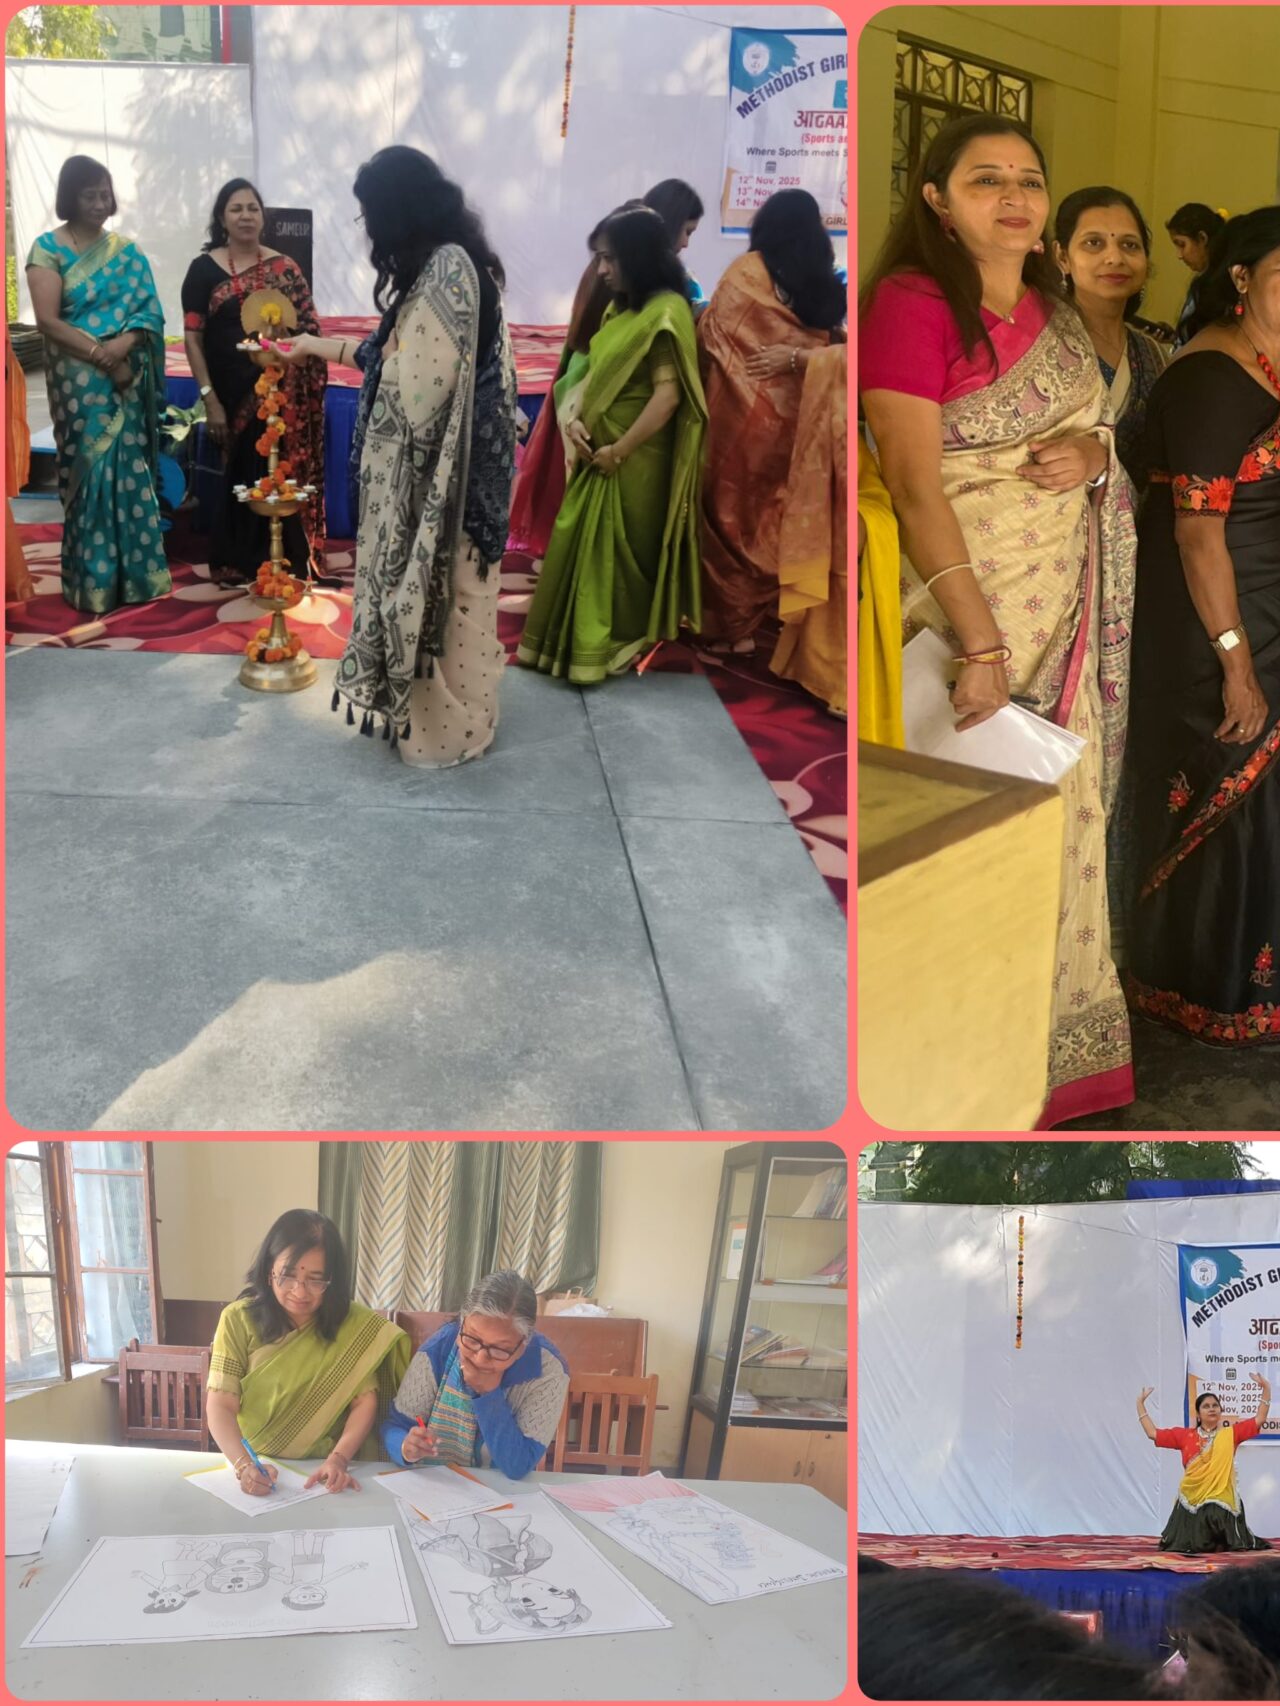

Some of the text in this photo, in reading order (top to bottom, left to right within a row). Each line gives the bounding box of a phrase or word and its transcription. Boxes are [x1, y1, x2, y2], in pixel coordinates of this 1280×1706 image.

[736, 61, 815, 119] METHODIST
[746, 147, 776, 156] Where
[778, 147, 809, 158] Sports
[811, 149, 840, 157] meets
[778, 176, 801, 185] 2025
[1191, 1273, 1264, 1328] METHODIST
[1205, 1354, 1234, 1363] Where
[1237, 1355, 1267, 1364] Sports
[1218, 1383, 1238, 1392] Nov,
[1241, 1405, 1258, 1413] 202
